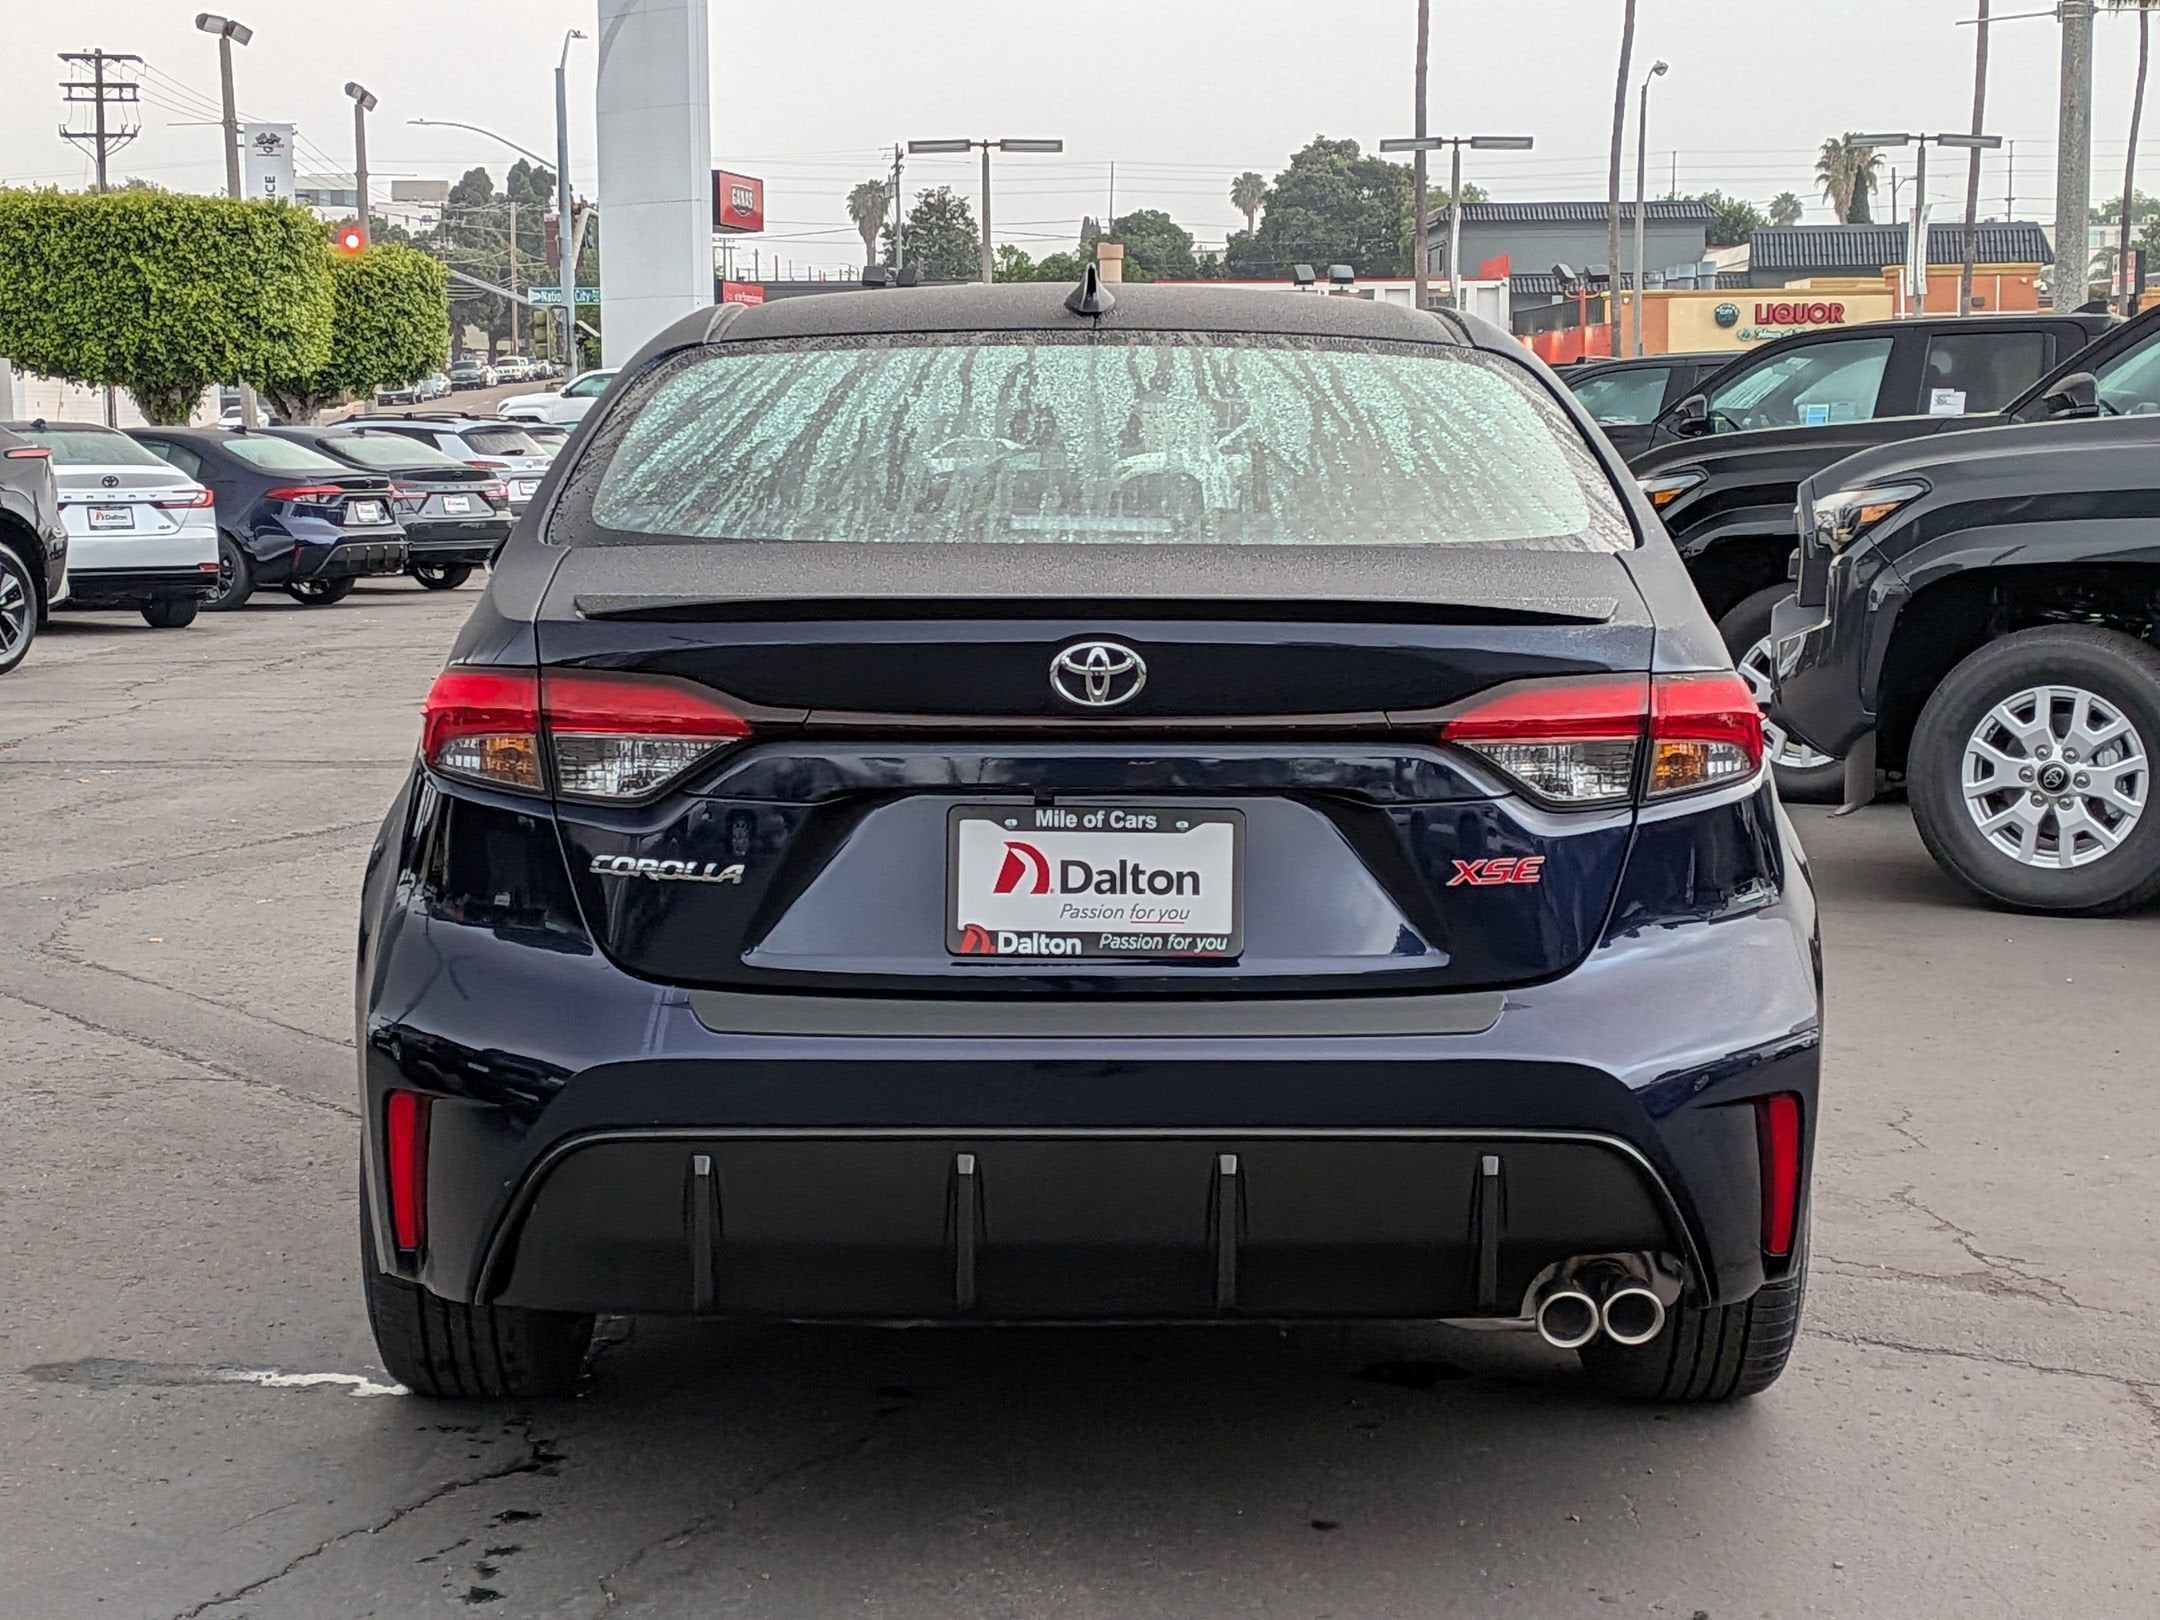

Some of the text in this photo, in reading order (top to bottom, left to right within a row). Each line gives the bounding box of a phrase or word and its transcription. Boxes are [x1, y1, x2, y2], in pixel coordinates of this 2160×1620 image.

[265, 176, 276, 198] ICE
[575, 288, 591, 303] City
[1755, 303, 1845, 325] LIQUOR
[105, 513, 128, 521] Dalton
[1036, 809, 1158, 830] Mile of Cars
[589, 854, 745, 884] COROLLA
[1060, 859, 1200, 896] Dalton
[1445, 855, 1546, 887] XSE
[1059, 903, 1191, 923] Passion for you
[997, 931, 1082, 955] Dalton
[1099, 933, 1228, 954] Passion for you
